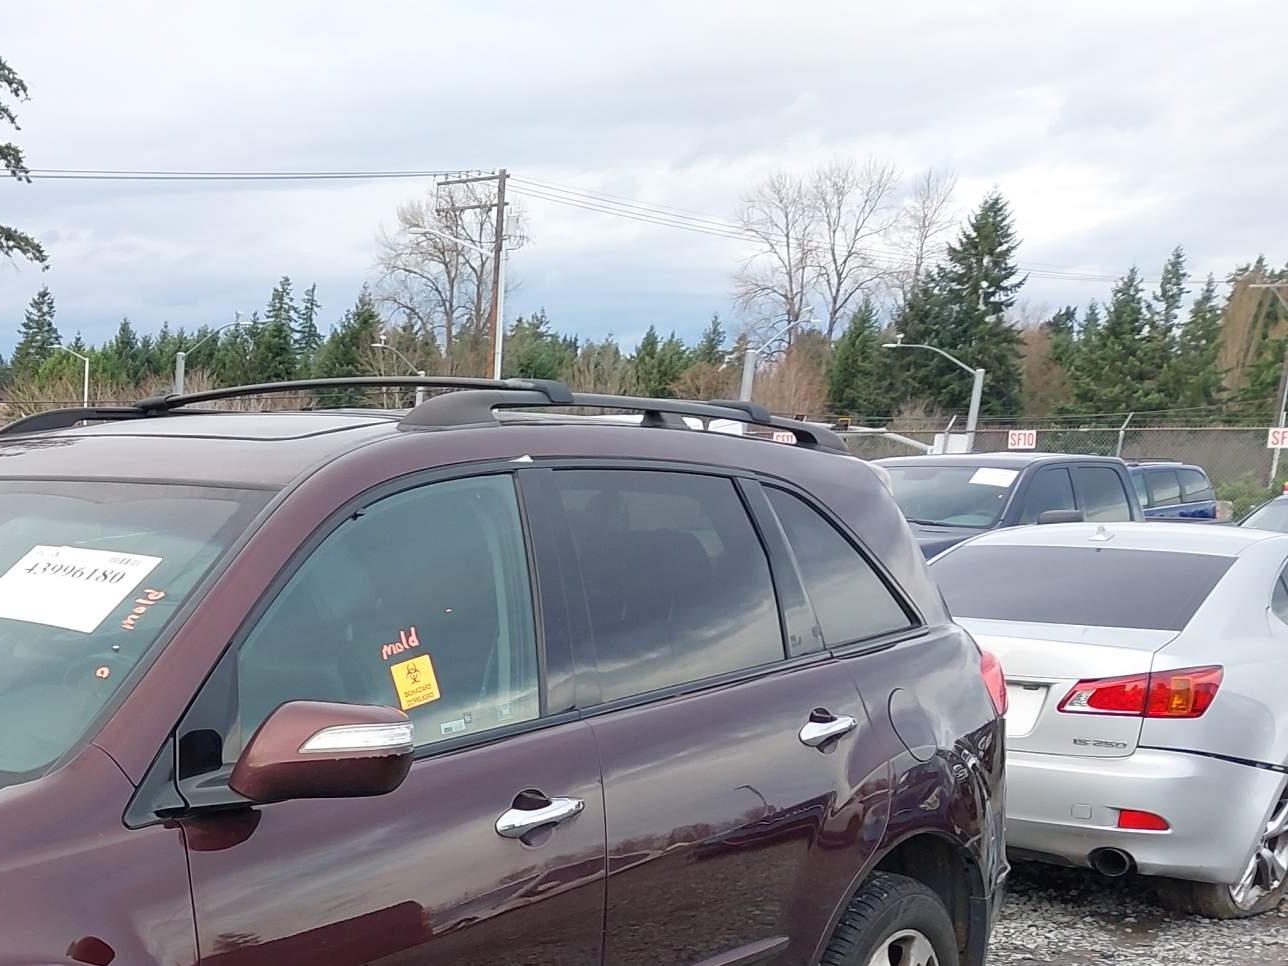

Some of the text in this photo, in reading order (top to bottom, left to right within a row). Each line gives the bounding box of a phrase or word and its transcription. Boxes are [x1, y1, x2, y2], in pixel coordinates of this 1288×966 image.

[1010, 432, 1034, 447] SF10
[25, 562, 126, 584] 43996180
[120, 588, 166, 630] mold
[382, 626, 420, 660] mold
